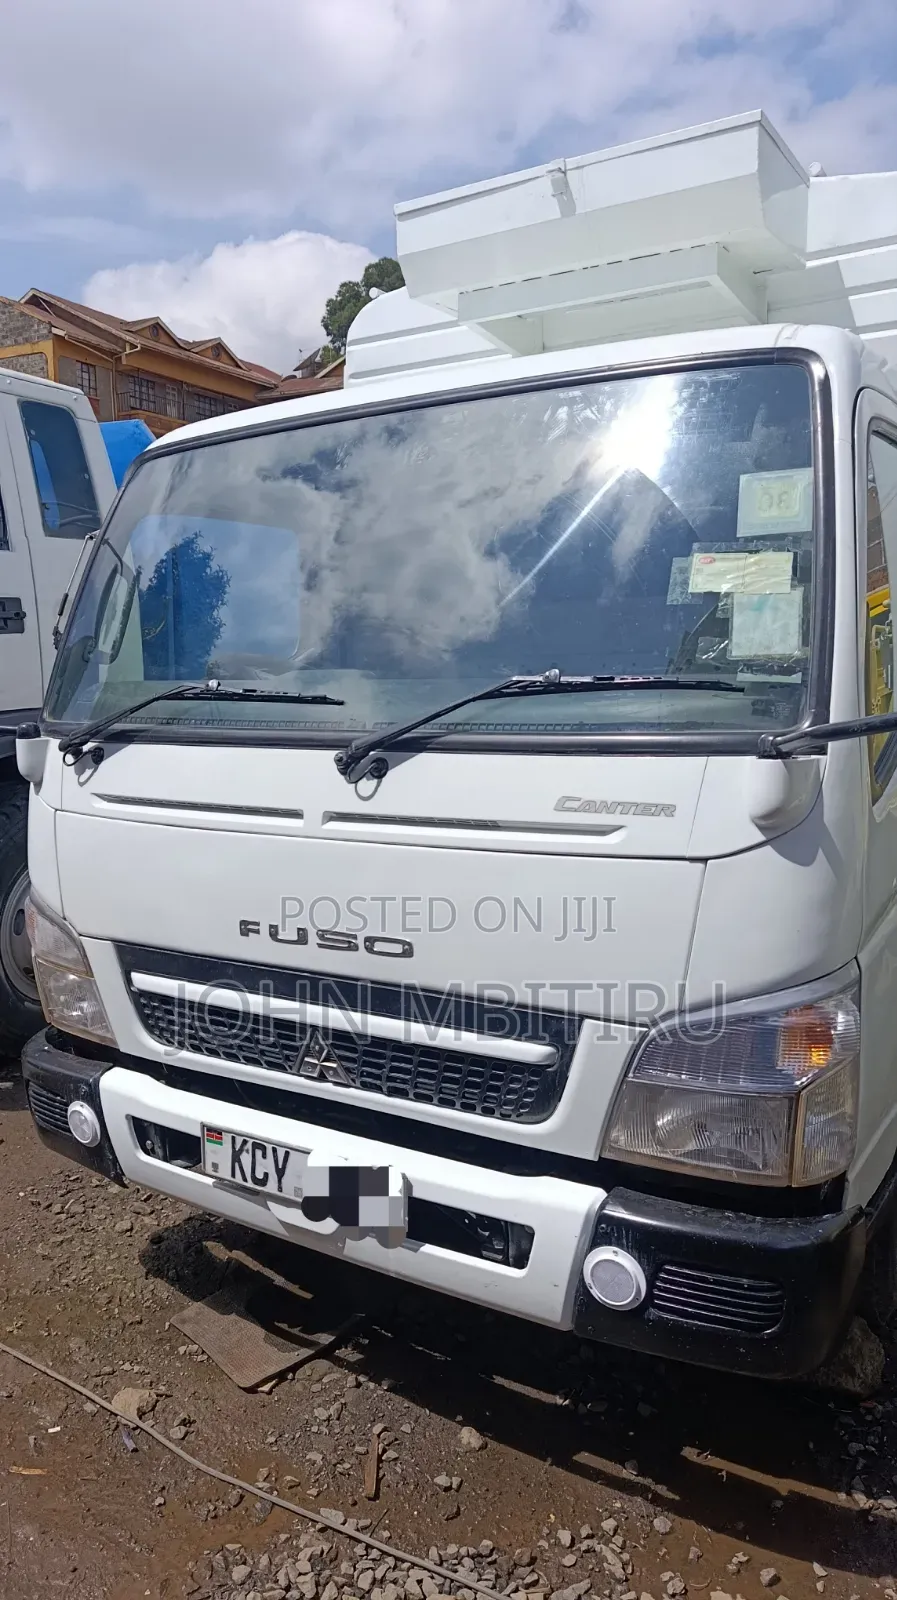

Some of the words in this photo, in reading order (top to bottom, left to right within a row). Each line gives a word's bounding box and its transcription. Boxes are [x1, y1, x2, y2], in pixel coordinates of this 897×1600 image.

[553, 795, 677, 818] CANTER
[238, 919, 414, 959] FUSO
[230, 1135, 290, 1193] KCY
